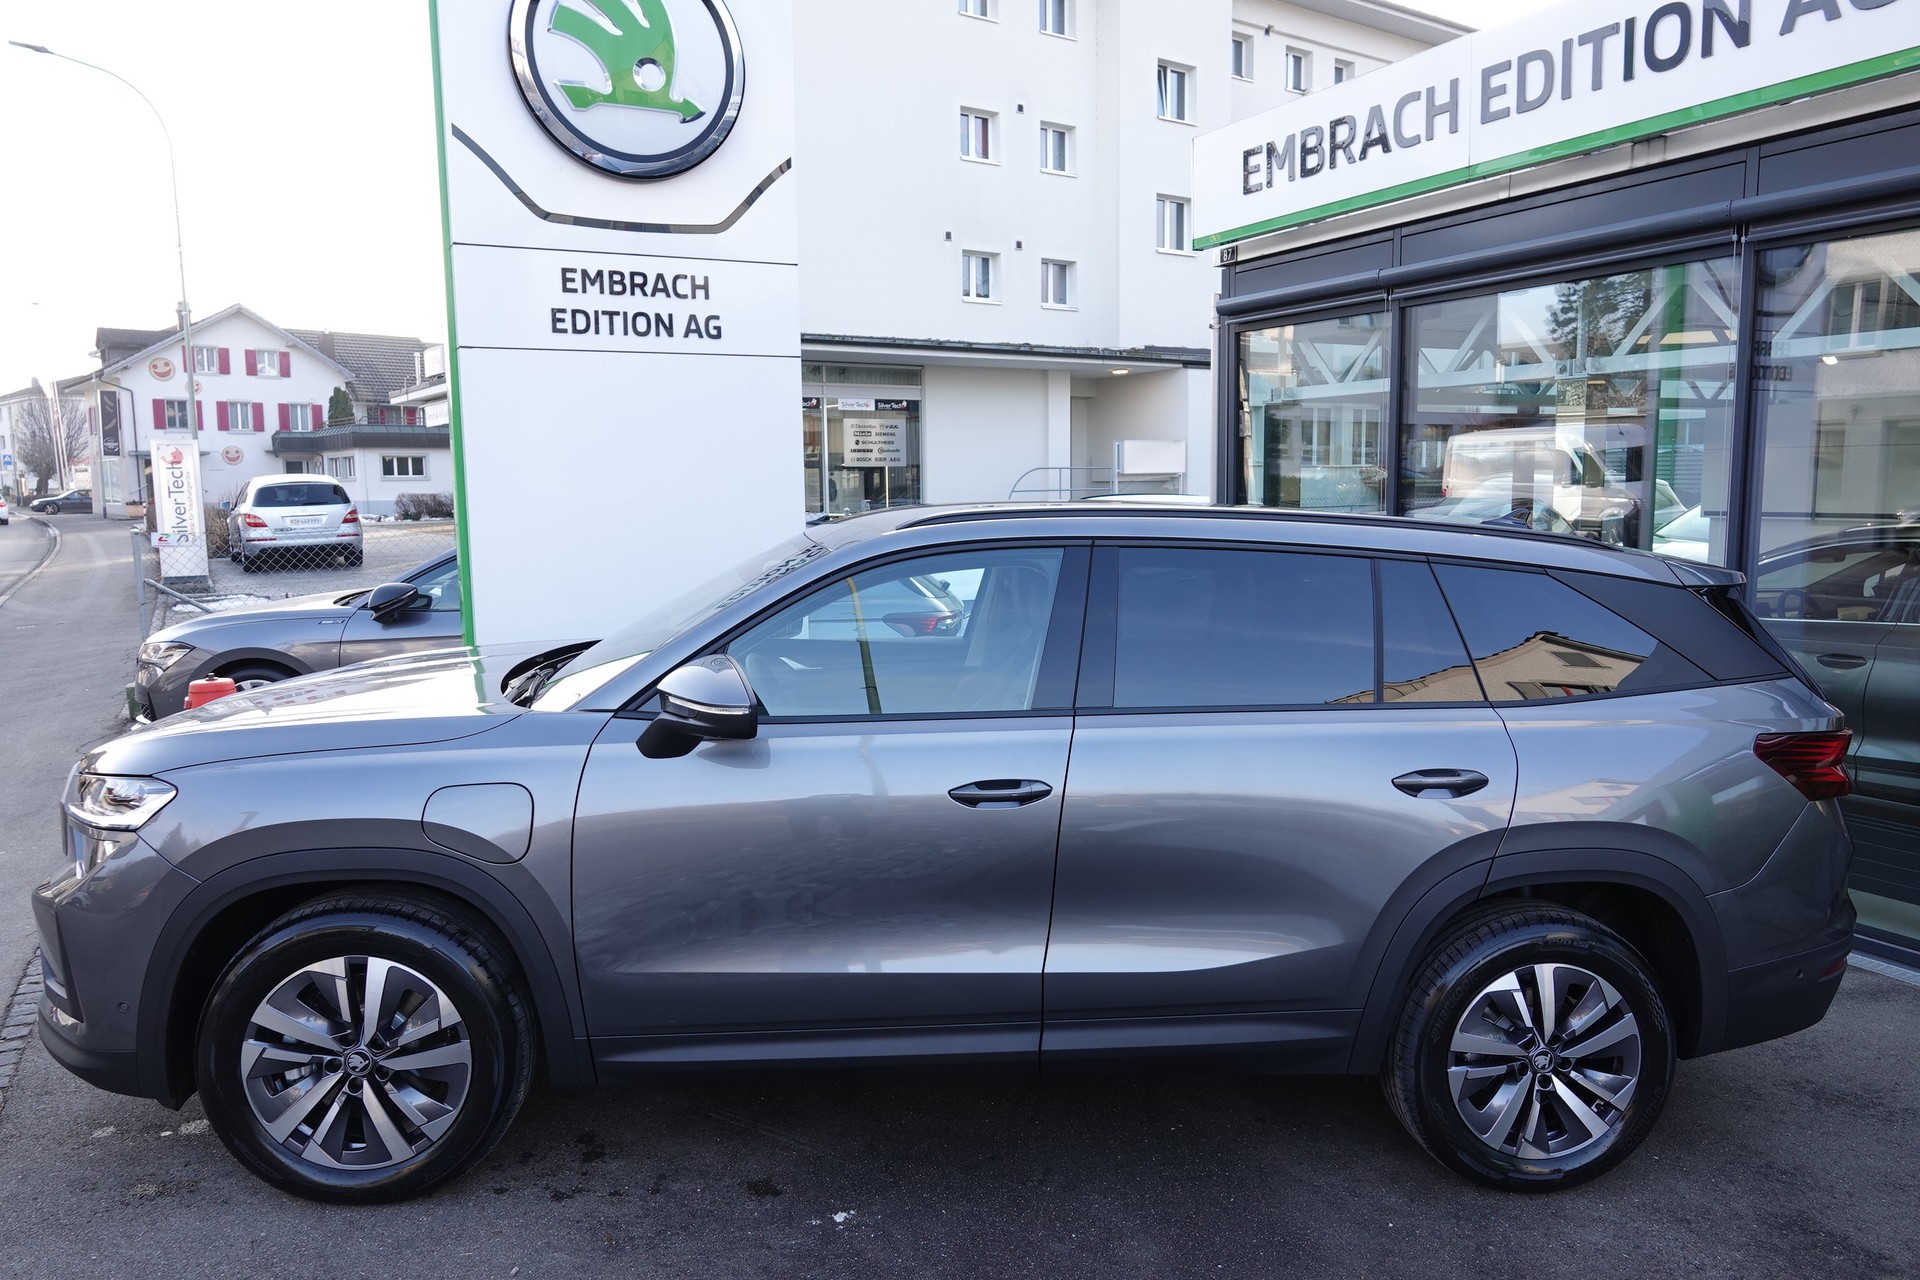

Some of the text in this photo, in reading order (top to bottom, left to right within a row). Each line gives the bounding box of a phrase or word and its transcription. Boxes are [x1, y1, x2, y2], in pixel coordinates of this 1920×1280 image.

[1243, 77, 1459, 195] EMBRACH
[1481, 0, 1750, 125] EDITION
[561, 267, 710, 300] EMBRACH
[551, 308, 722, 339] EDITION AG
